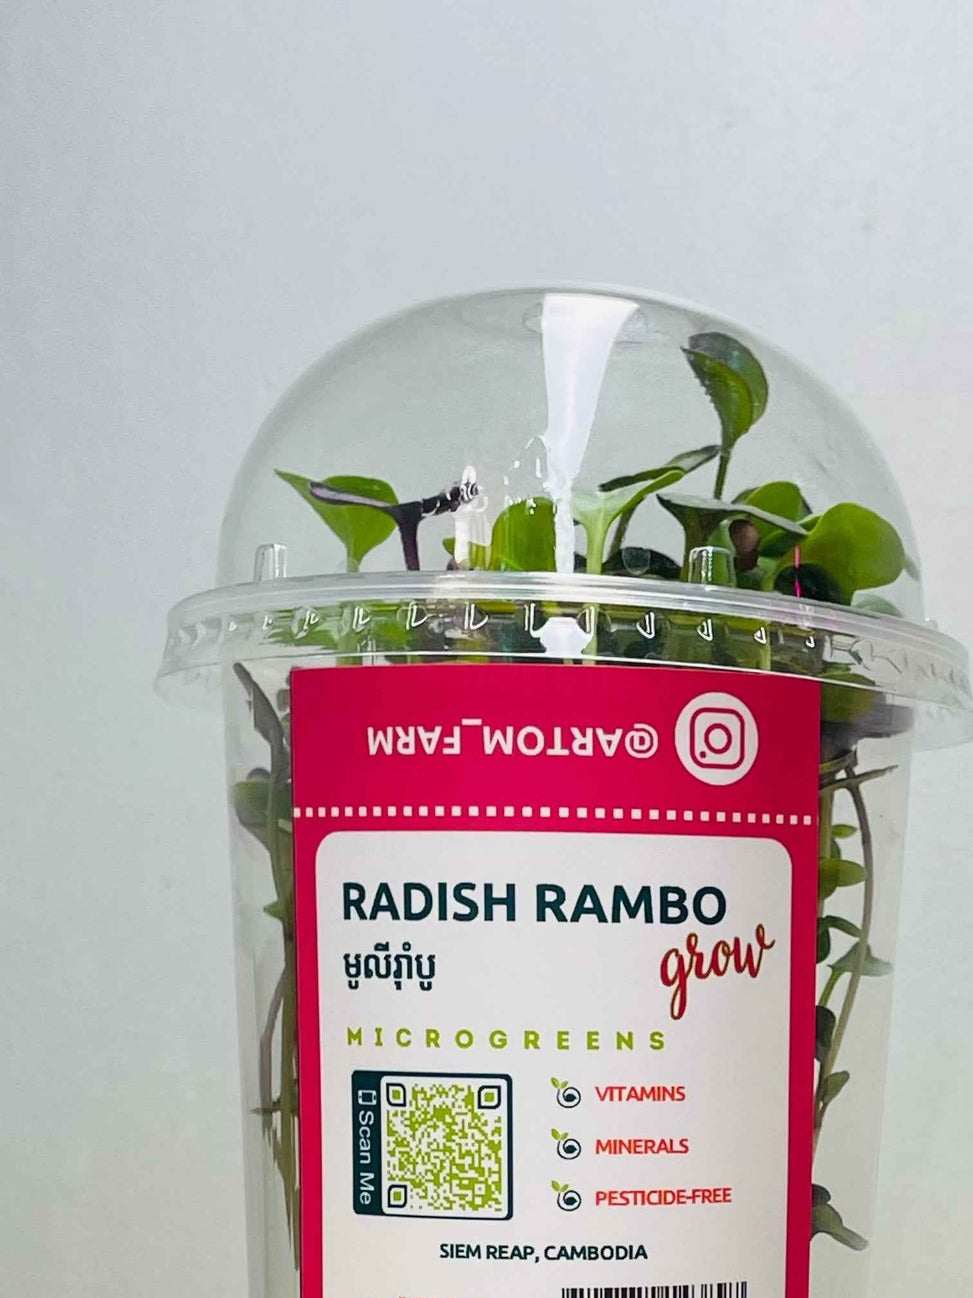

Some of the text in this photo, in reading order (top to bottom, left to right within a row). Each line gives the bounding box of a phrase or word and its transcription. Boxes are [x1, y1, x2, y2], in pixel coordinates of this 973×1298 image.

[368, 719, 658, 758] @ARTOM_FARM
[343, 882, 726, 925] RADISH RAMBO
[660, 924, 775, 1020] grow
[347, 1027, 664, 1050] MICROGREENS
[595, 1086, 685, 1101] VITAMINS
[359, 1111, 374, 1204] Scan Me
[596, 1139, 689, 1154] MINERALS
[596, 1188, 732, 1205] PESTICIDE-FREE
[440, 1244, 648, 1263] SIEM REAP, CAMBODIA
